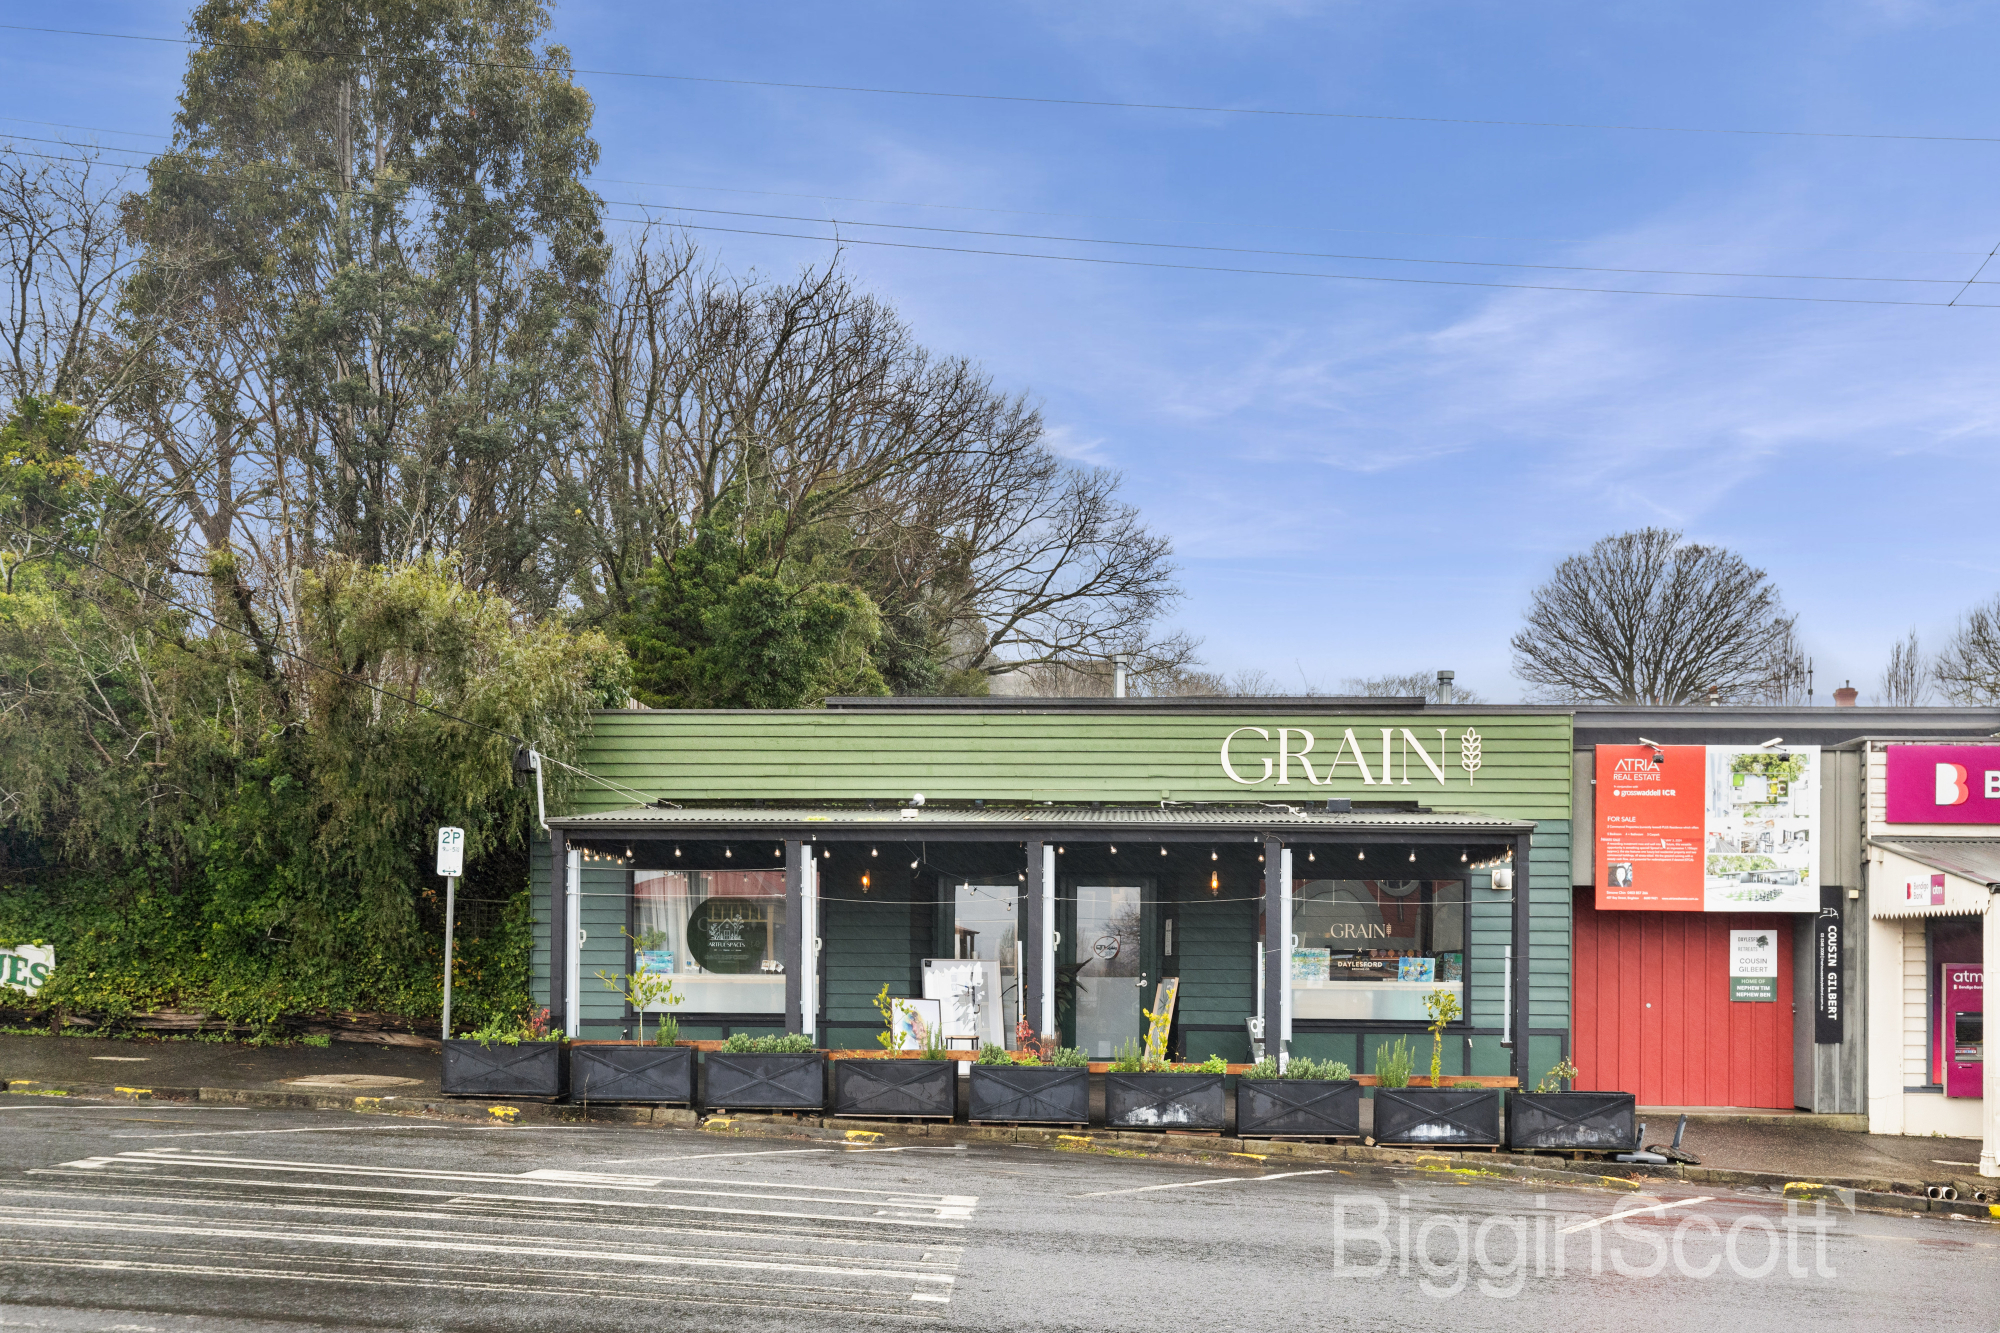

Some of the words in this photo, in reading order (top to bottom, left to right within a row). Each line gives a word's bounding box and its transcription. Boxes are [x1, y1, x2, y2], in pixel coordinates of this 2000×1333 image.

[1220, 726, 1448, 786] GRAIN
[1614, 758, 1660, 771] ATRIA
[442, 831, 460, 844] 2P
[1913, 882, 1929, 892] Bendigo
[1913, 892, 1923, 900] Bank
[1330, 923, 1385, 938] GRAIN
[1828, 925, 1837, 967] COUSIN
[1953, 970, 1983, 983] atm
[1828, 972, 1837, 1020] GILBERT
